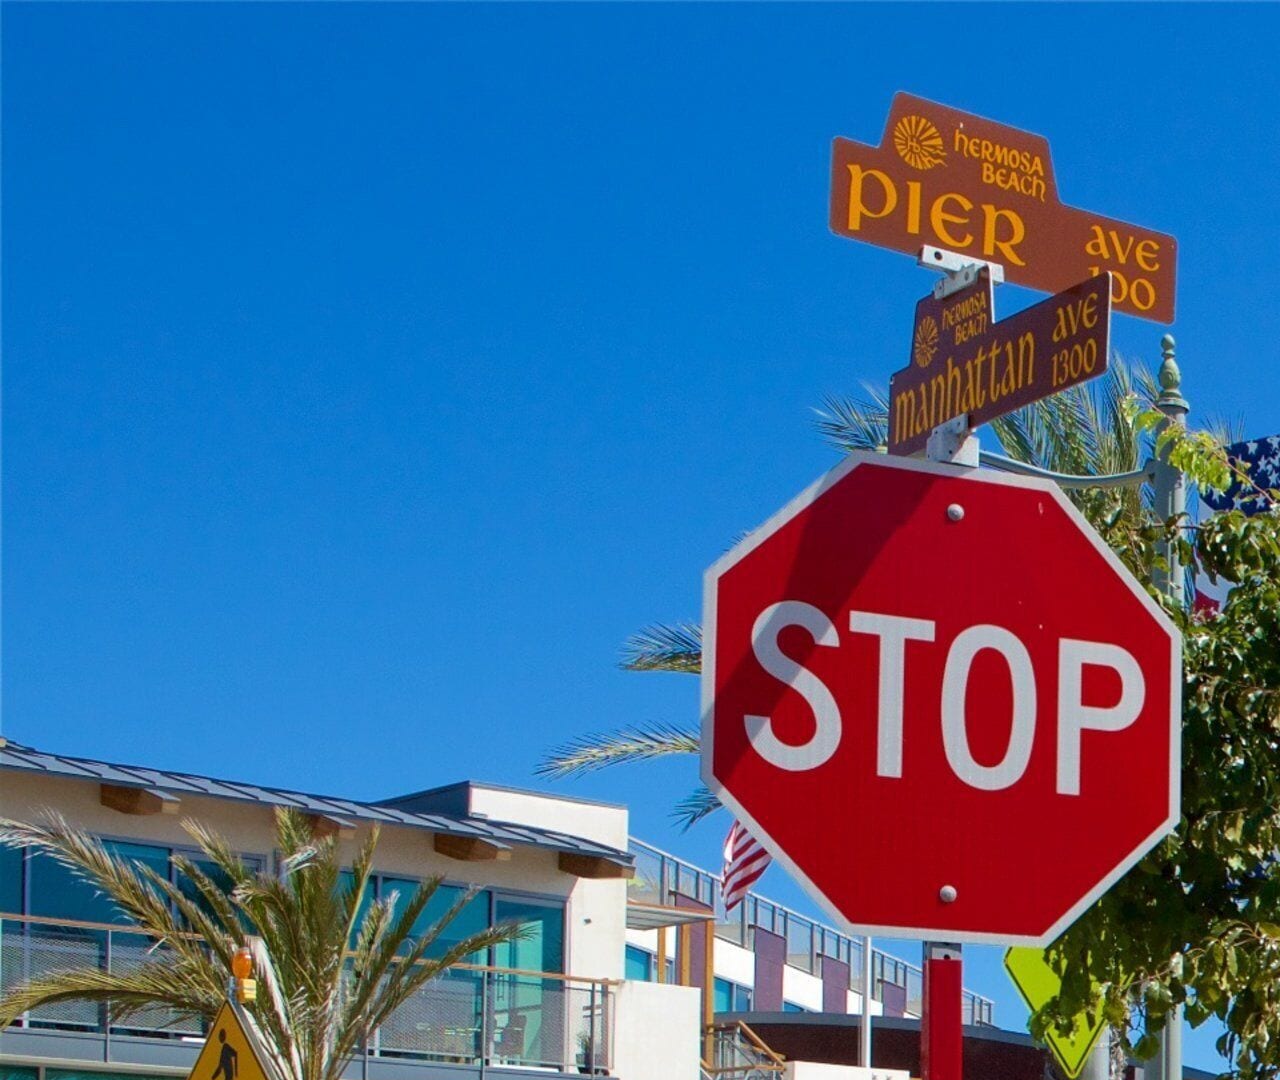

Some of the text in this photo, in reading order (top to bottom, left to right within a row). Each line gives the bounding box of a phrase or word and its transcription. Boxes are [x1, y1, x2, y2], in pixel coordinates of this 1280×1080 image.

[846, 163, 1026, 267] PIER
[1051, 337, 1098, 388] 1300
[744, 600, 1146, 796] STOP
